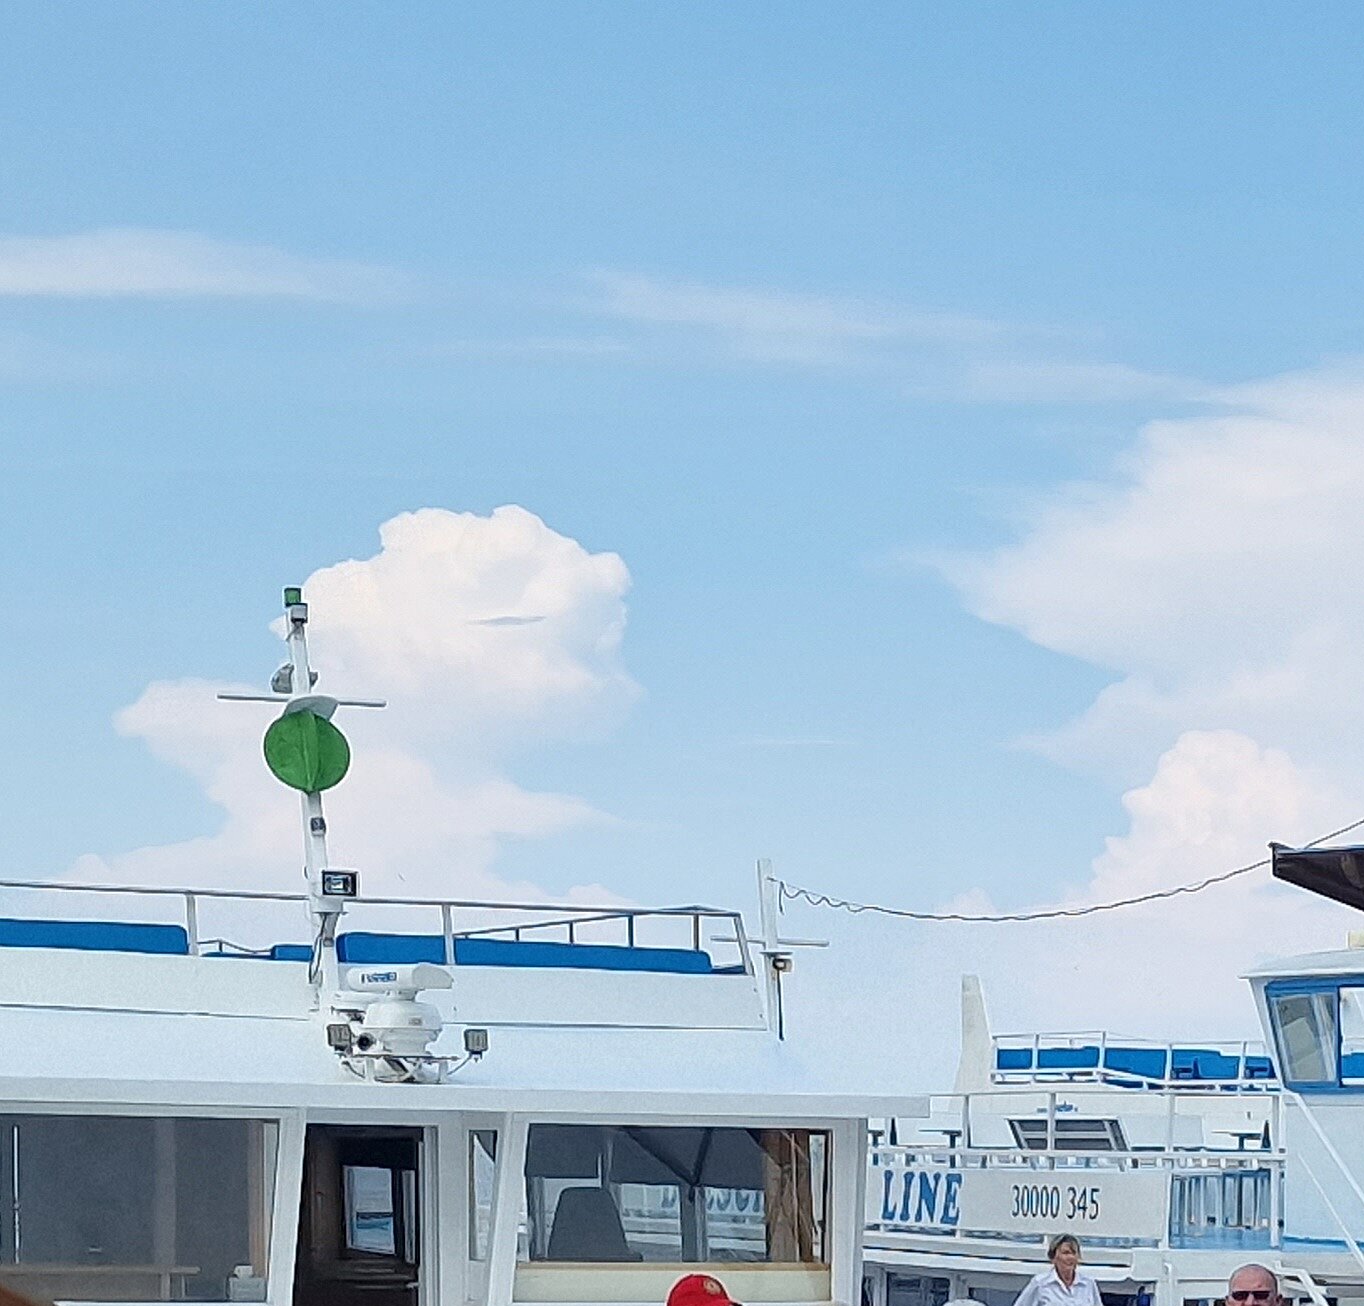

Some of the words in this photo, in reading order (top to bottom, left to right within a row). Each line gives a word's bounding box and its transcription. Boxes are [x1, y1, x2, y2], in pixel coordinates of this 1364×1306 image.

[881, 1170, 962, 1225] LINE
[1011, 1184, 1060, 1219] 30000
[1065, 1186, 1101, 1220] 345
